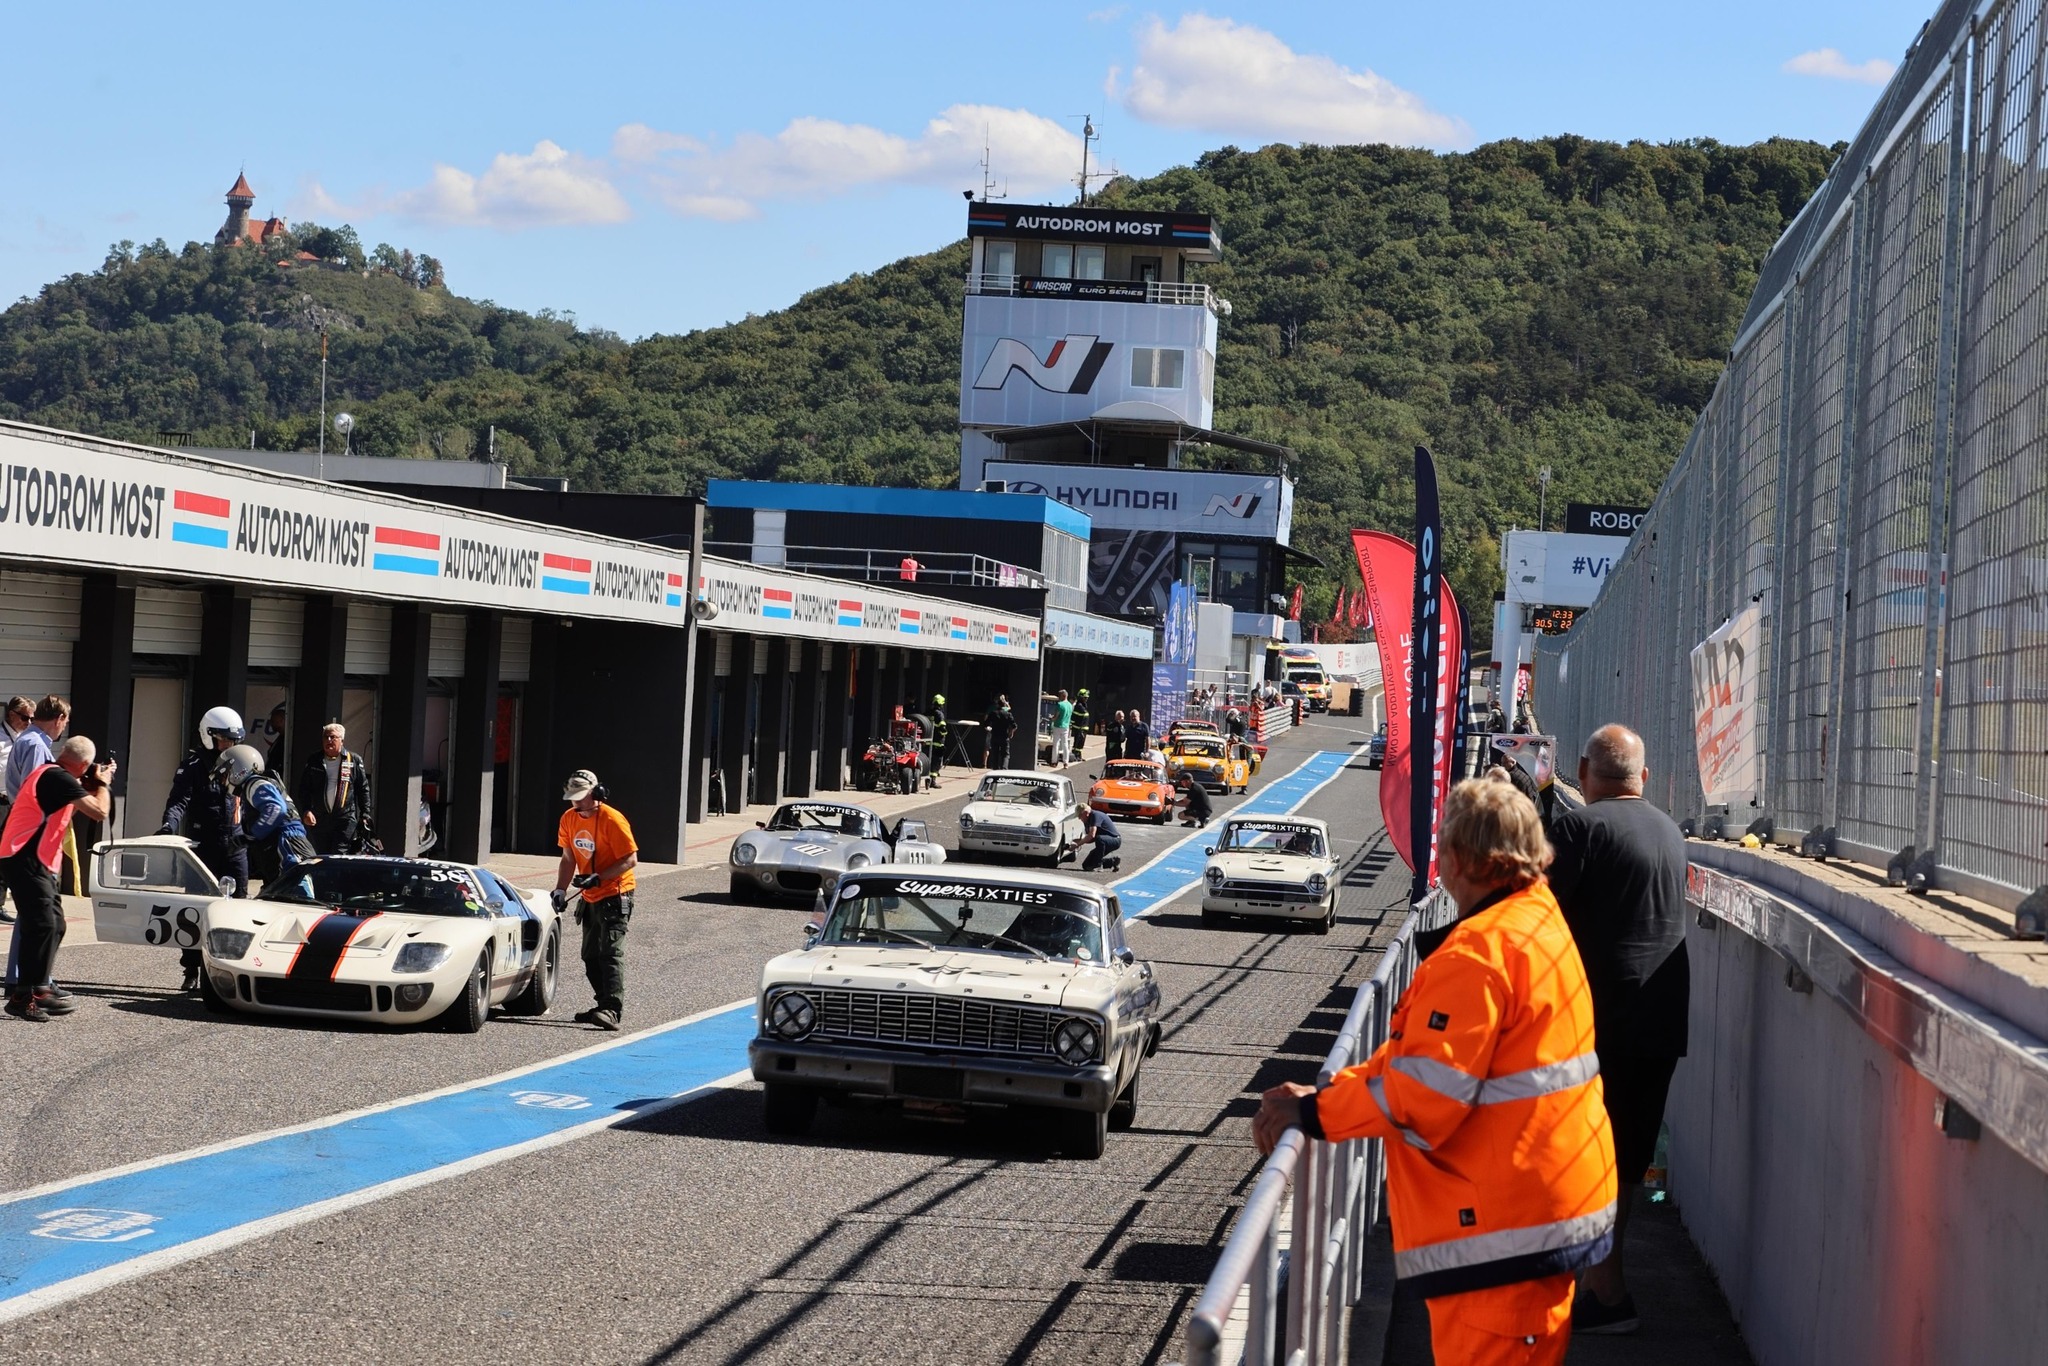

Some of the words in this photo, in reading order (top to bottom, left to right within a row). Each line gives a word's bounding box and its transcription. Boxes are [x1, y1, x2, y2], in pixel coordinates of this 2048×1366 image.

[1016, 215, 1111, 233] AUTODROM
[1115, 221, 1164, 236] MOST
[1035, 281, 1072, 292] NASCAR
[1078, 287, 1106, 295] EURO
[1109, 289, 1144, 297] SERIES
[0, 463, 105, 533] UTODROM
[110, 481, 165, 539] MOST
[1056, 486, 1178, 510] HYUNDAI
[236, 502, 327, 563] AUTODROM
[329, 519, 370, 568] MOST
[444, 536, 508, 586] AUTODROM
[509, 548, 539, 589] MOST
[593, 561, 641, 601] AUTODROM
[641, 568, 665, 604] MOST
[743, 584, 761, 615] MOST
[1535, 619, 1553, 628] 30.5
[1552, 610, 1574, 620] 12:33
[430, 869, 466, 884] 58
[895, 880, 1053, 905] SuperSIXTIES
[145, 904, 201, 948] 58
